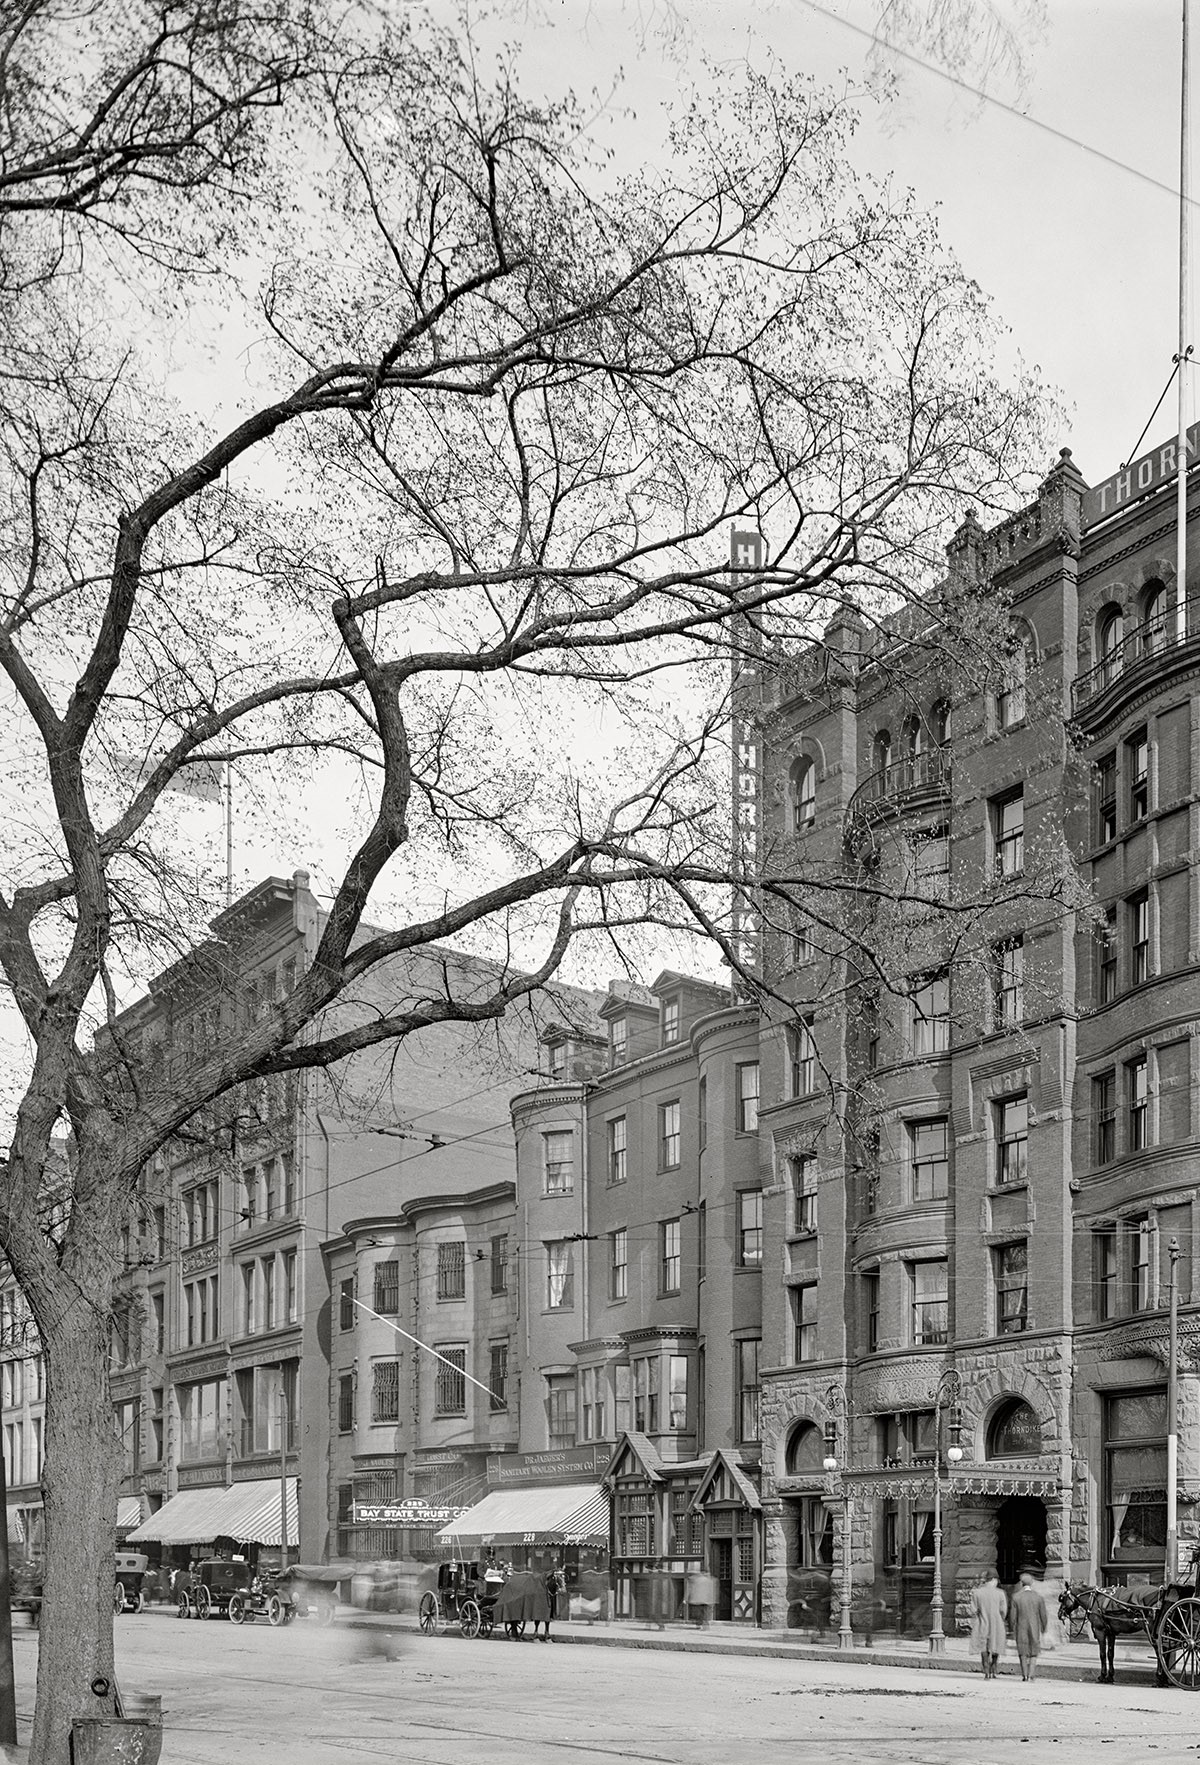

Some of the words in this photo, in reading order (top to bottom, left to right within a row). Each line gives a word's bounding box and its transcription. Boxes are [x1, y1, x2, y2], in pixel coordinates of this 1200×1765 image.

[1003, 1425, 1041, 1435] THORNDIKE
[597, 1454, 610, 1464] 228
[557, 1462, 583, 1473] SYSTEM
[360, 1509, 381, 1518] BAY
[384, 1509, 414, 1518] STATE
[417, 1509, 450, 1518] TRUST
[523, 1533, 536, 1542] 228
[564, 1533, 590, 1545] Jaeger
